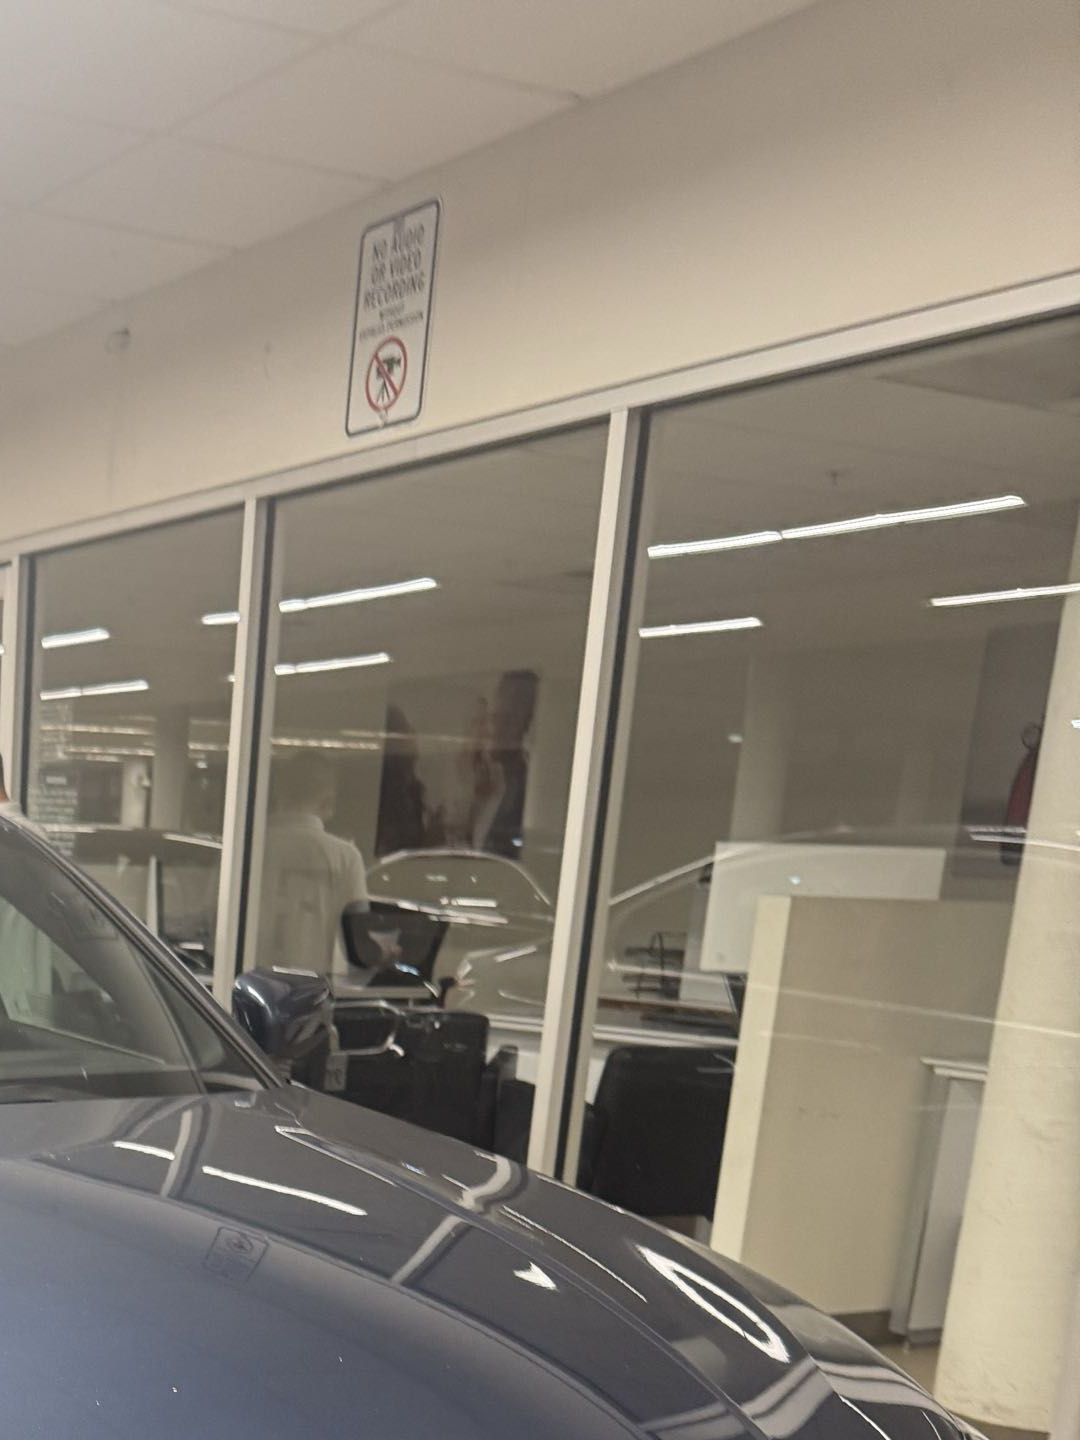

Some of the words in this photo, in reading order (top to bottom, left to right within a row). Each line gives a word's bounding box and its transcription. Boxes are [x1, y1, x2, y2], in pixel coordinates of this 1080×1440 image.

[371, 238, 388, 260] NO
[390, 223, 424, 254] AUDIO
[371, 261, 387, 287] OR
[389, 246, 422, 279] VIDEO
[363, 269, 425, 311] RECORDING
